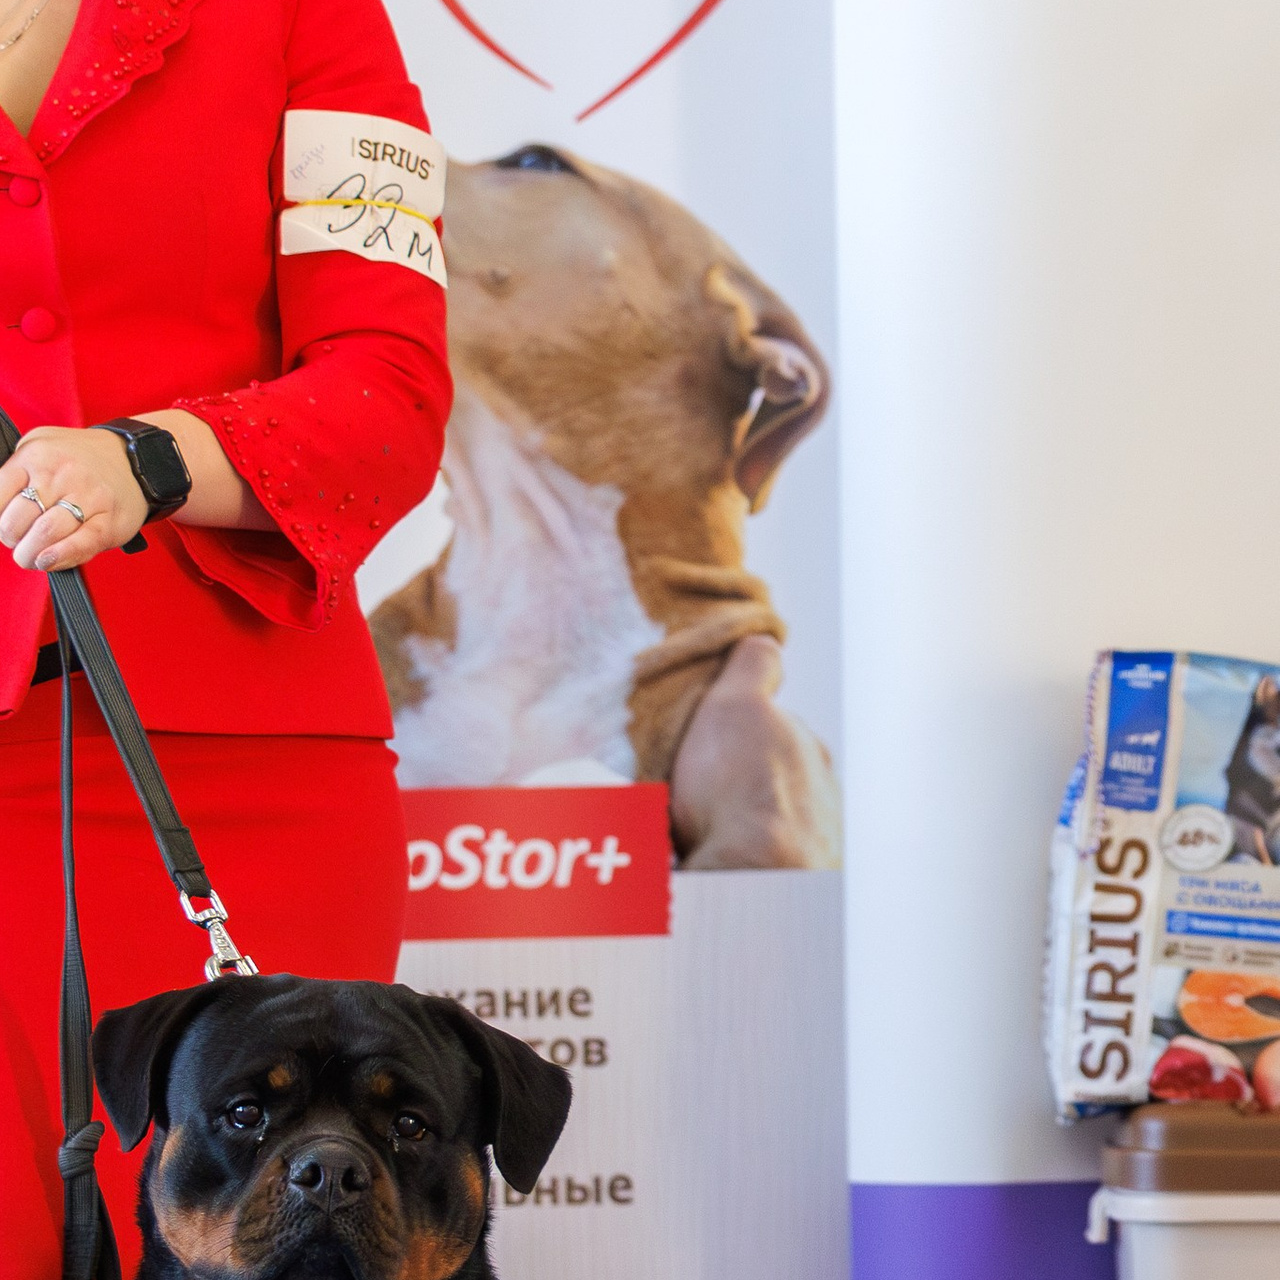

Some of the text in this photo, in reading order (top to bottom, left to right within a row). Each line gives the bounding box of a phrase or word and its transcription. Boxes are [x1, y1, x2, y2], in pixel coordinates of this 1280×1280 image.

[358, 138, 432, 181] SIRIUS
[406, 823, 632, 893] oStor+
[1078, 835, 1152, 1082] SIRIUS
